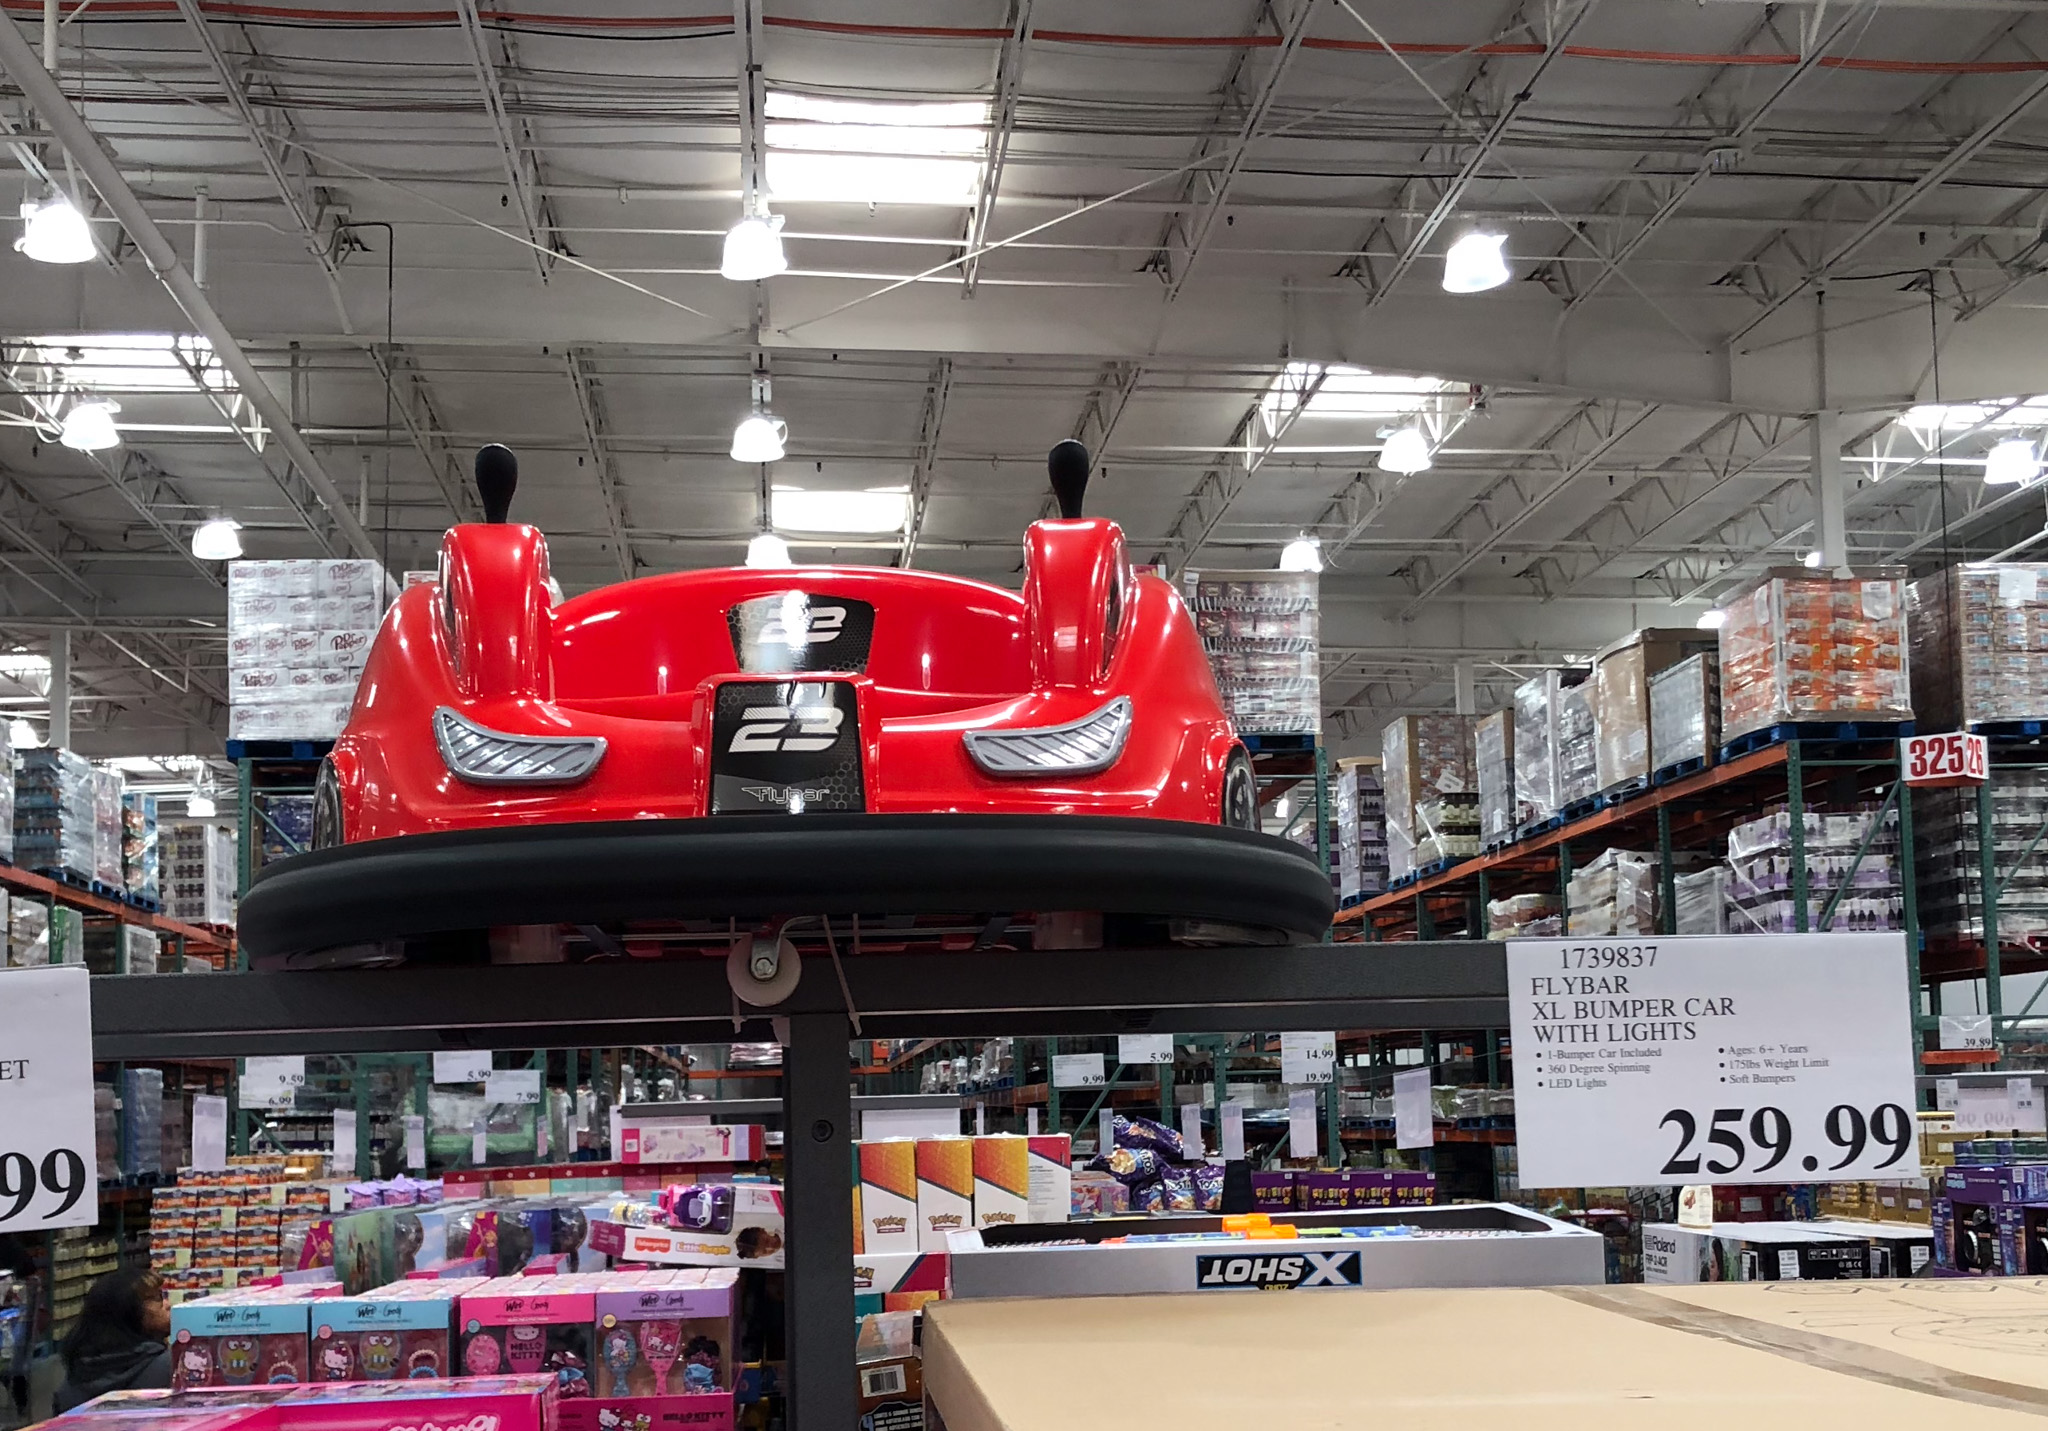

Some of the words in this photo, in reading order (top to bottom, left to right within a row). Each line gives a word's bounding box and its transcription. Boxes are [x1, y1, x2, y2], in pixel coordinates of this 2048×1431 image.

[728, 706, 844, 753] 23
[1909, 736, 1964, 777] 325
[1967, 737, 1984, 776] 26
[1561, 946, 1658, 969] 1739837
[1531, 975, 1630, 996] FLYBAR
[1532, 1002, 1565, 1020] XL
[1574, 999, 1677, 1020] BUMPER
[1684, 998, 1736, 1017] CAR
[1533, 1024, 1599, 1043] WITH
[1608, 1021, 1697, 1042] LIGHTS
[1306, 1050, 1334, 1059] 14.99
[1548, 1049, 1595, 1061] 1-Bumper
[1599, 1049, 1617, 1058] Car
[1620, 1048, 1662, 1058] Included
[1727, 1045, 1753, 1056] Ages:
[1759, 1045, 1774, 1054] 6+
[1780, 1044, 1808, 1054] Years
[1150, 1052, 1173, 1062] 5.99
[0, 1060, 29, 1080] ET
[1548, 1064, 1566, 1074] 360
[1570, 1064, 1604, 1075] Degree
[1608, 1063, 1651, 1074] Spinning
[1729, 1059, 1760, 1069] 175lbs
[1764, 1058, 1799, 1070] Weight
[1802, 1058, 1829, 1068] Limit
[467, 1070, 492, 1081] 5.99
[1082, 1075, 1104, 1085] 9.99
[1305, 1072, 1333, 1082] 19.99
[1729, 1074, 1749, 1084] Soft
[1753, 1074, 1796, 1086] Bumpers
[1549, 1079, 1572, 1088] LED
[1576, 1078, 1607, 1090] Lights
[516, 1092, 539, 1102] 7.99
[1659, 1103, 1912, 1175] 259.99
[0, 1149, 86, 1222] 99
[1653, 1236, 1675, 1254] Roland
